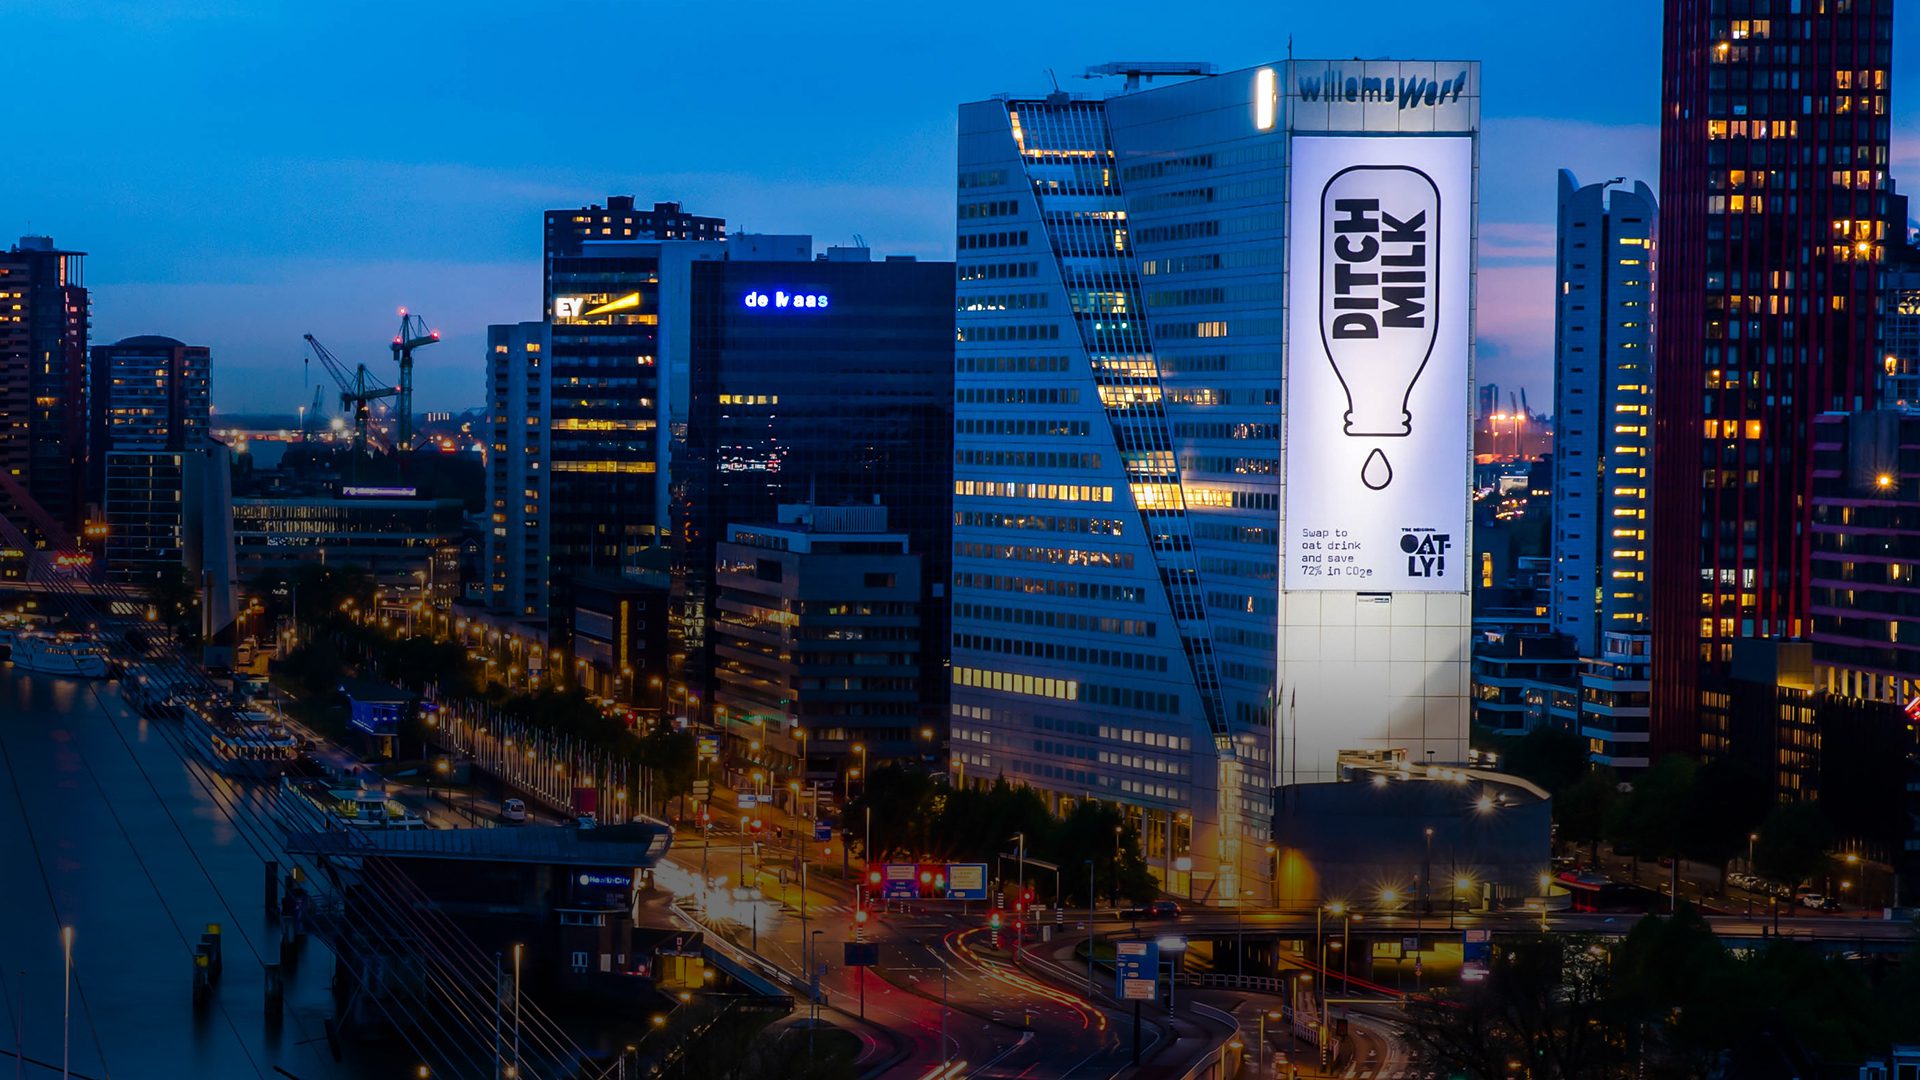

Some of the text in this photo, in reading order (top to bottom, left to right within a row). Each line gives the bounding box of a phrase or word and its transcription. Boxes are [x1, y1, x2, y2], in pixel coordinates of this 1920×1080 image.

[1333, 199, 1379, 339] DITCH
[1381, 209, 1426, 328] MILK
[556, 297, 584, 317] EY
[745, 291, 768, 307] de
[1302, 528, 1348, 539] Swap to
[1302, 541, 1361, 550] oat drink
[1301, 554, 1354, 563] and save
[1408, 555, 1445, 578] LY!
[1301, 565, 1322, 576] 72%
[1327, 566, 1341, 576] in
